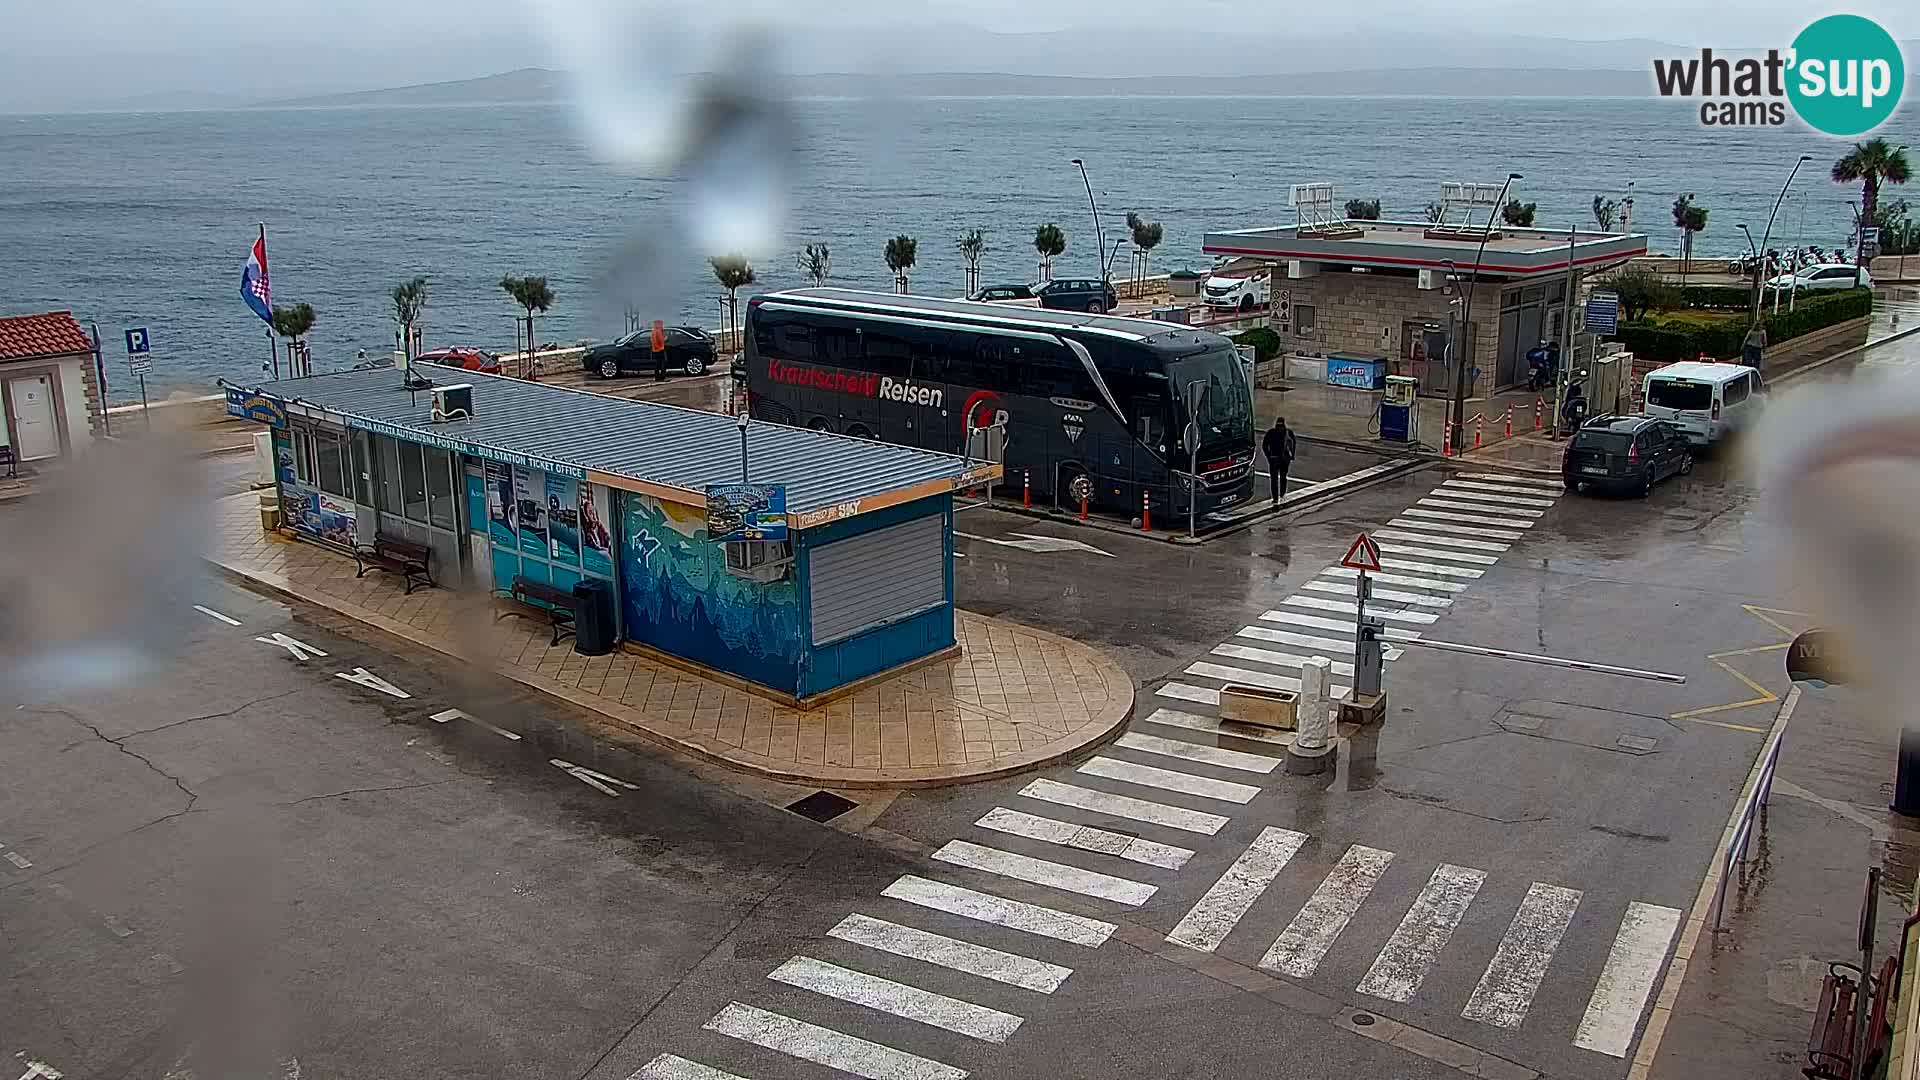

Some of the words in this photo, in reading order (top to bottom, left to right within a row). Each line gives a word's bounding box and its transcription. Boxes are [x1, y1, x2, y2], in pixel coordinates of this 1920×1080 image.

[131, 332, 143, 350] P
[768, 359, 881, 397] Krautscheid
[879, 376, 943, 408] Reisen
[396, 428, 437, 445] AUTOBUSNA
[437, 437, 468, 453] POSTAJA
[478, 446, 493, 458] BUS
[494, 450, 526, 466] STATION
[527, 457, 555, 472] TICKET
[555, 462, 582, 478] OFFICE
